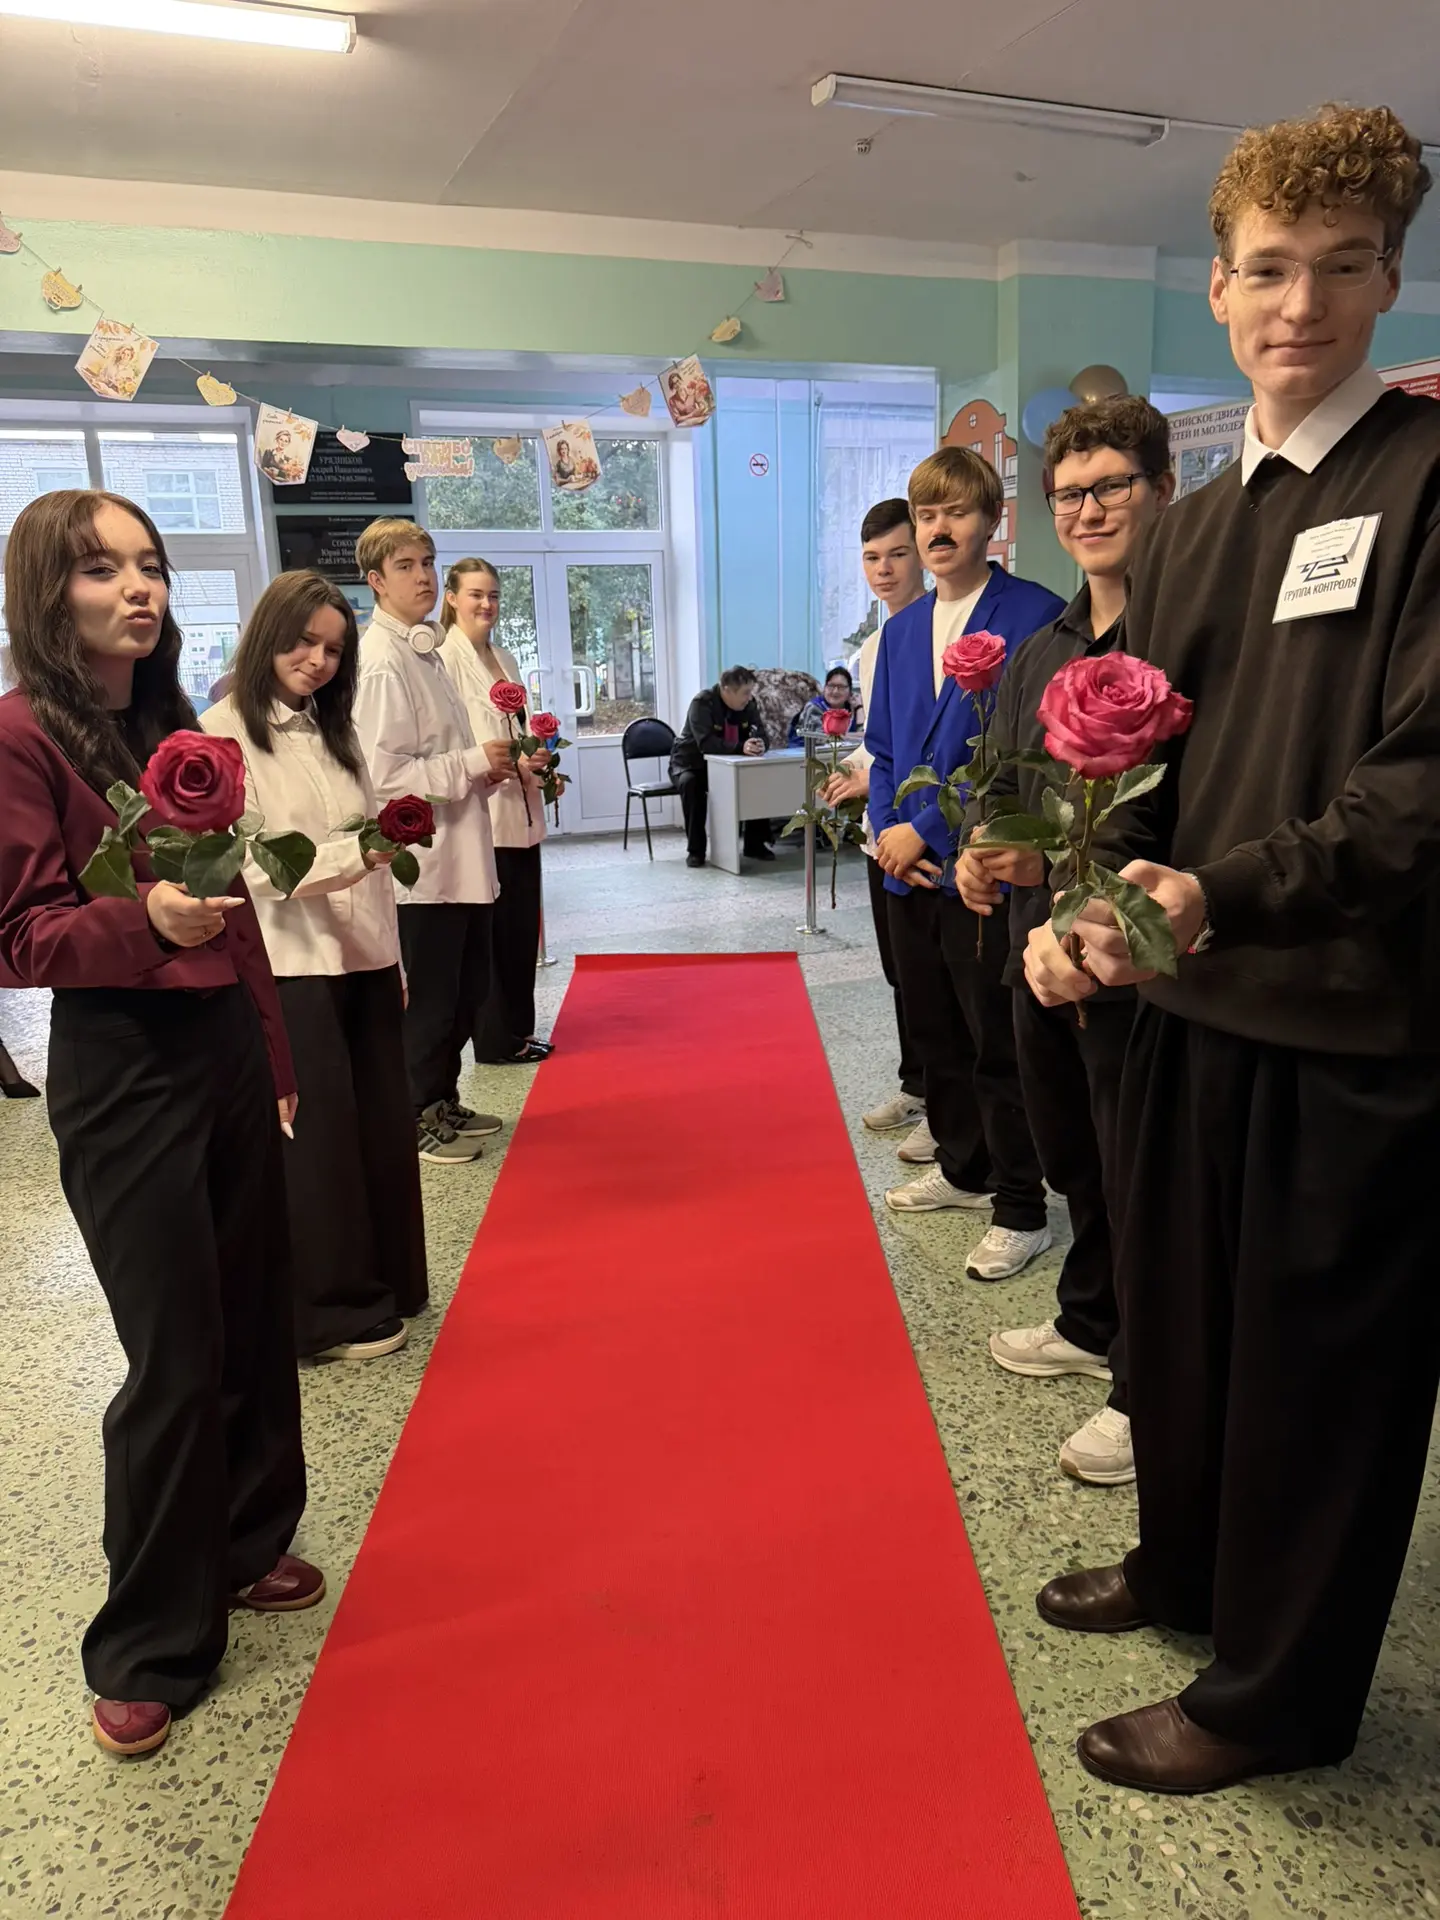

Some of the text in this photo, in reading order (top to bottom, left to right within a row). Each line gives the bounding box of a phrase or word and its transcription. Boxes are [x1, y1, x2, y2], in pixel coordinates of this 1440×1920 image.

[1193, 428, 1199, 437] И
[403, 440, 471, 455] СПАСИБО
[1284, 577, 1358, 602] ГРУППА КОНТРОЛЯ
